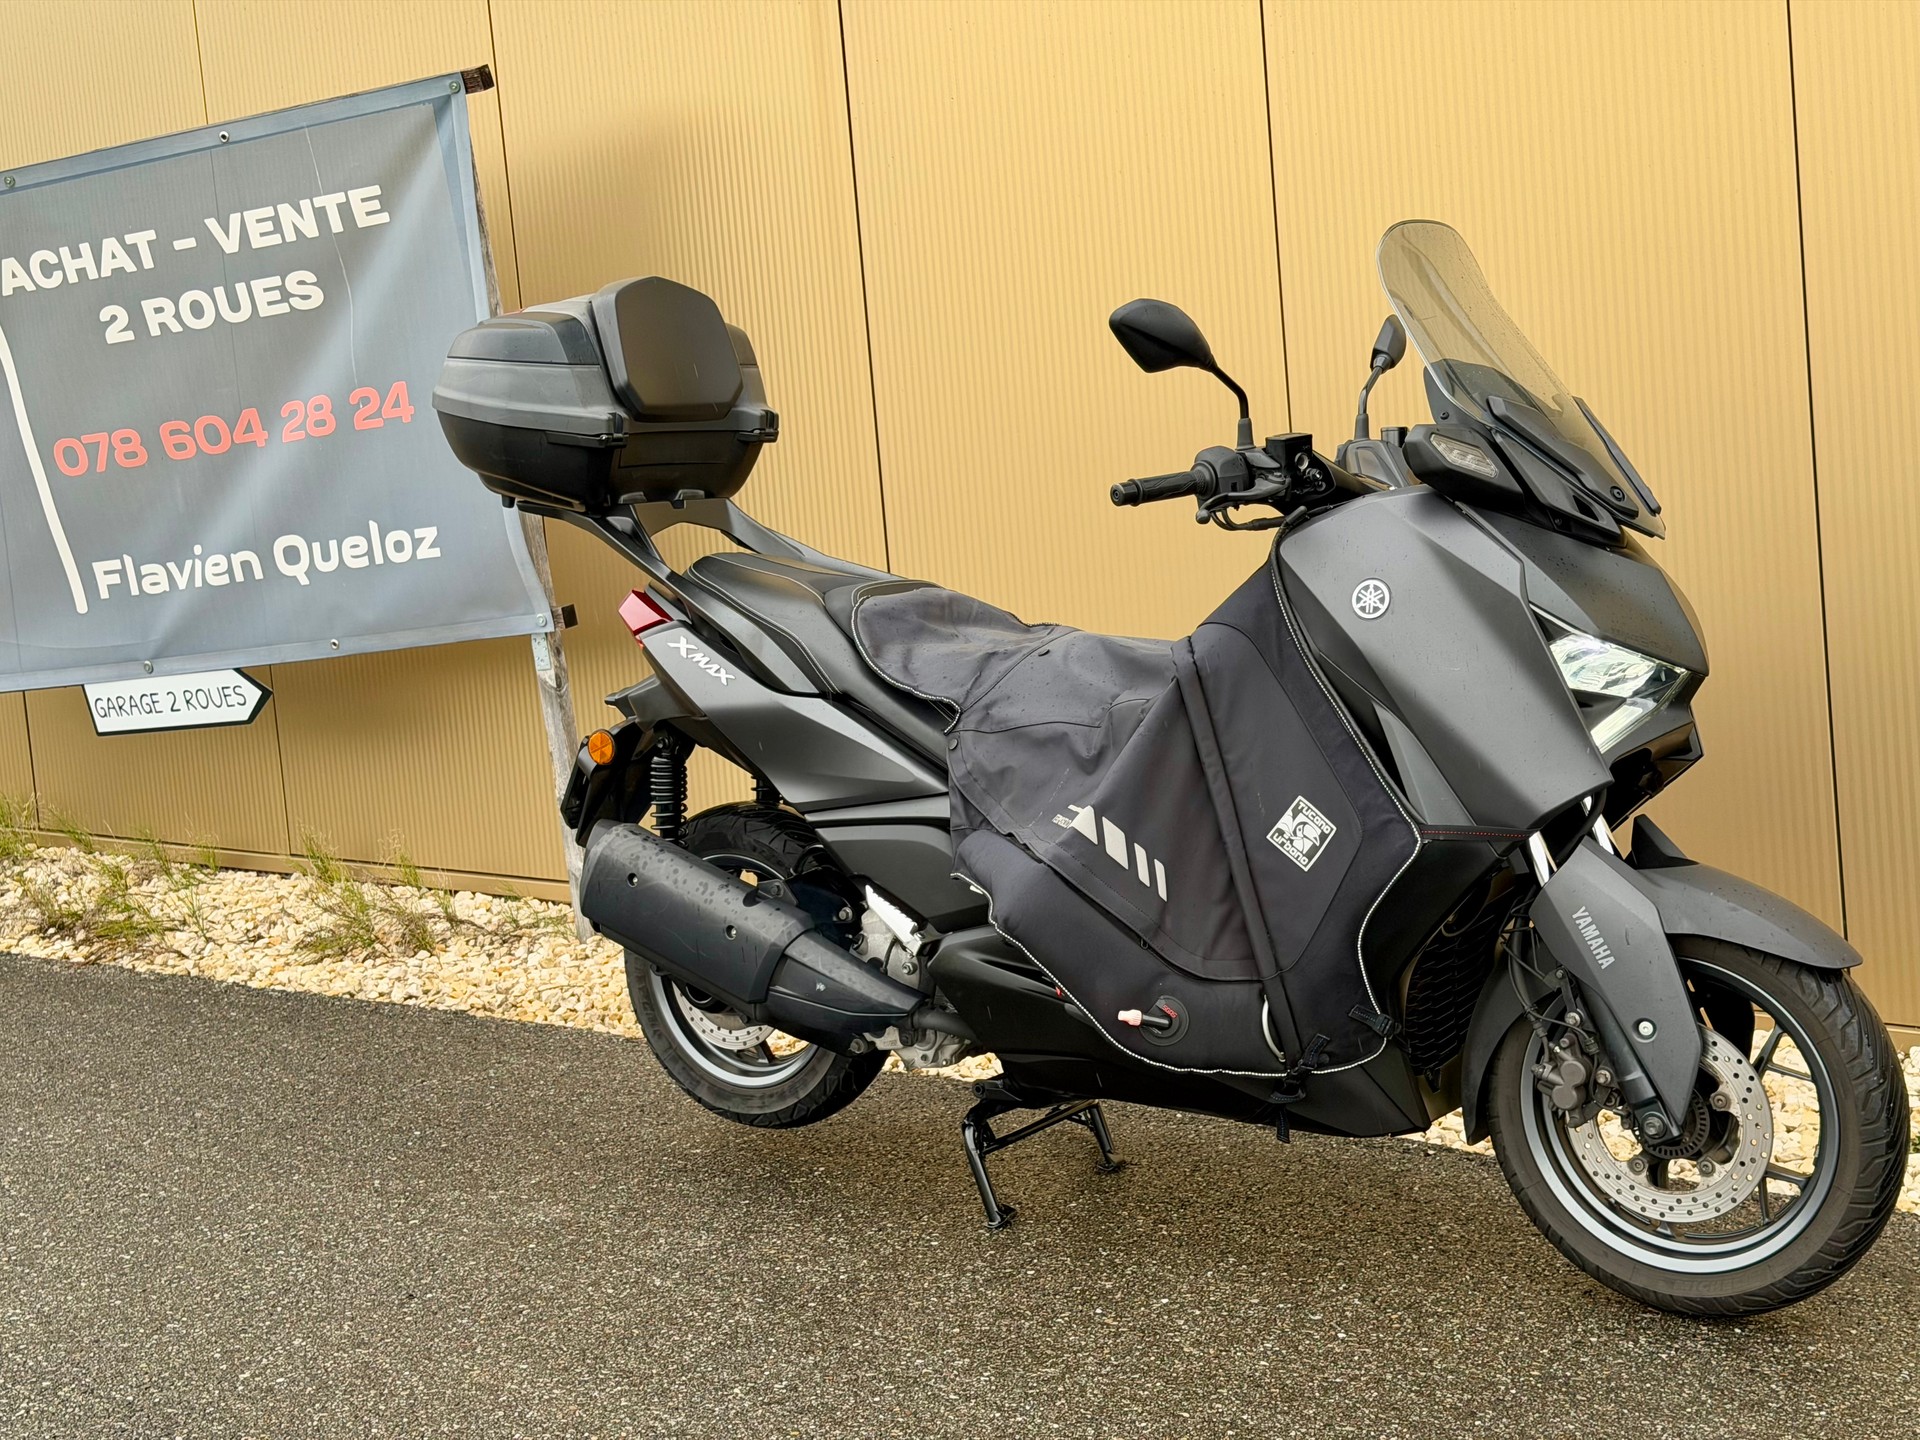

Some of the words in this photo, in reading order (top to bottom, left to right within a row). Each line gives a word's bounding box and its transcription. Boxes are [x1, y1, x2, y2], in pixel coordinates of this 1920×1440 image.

[1, 229, 157, 297] ACHAT
[172, 236, 198, 252] -
[204, 184, 391, 255] VENTE
[99, 304, 136, 345] 2
[140, 269, 325, 337] ROUES
[53, 428, 148, 477] 078
[159, 407, 269, 461] 604
[280, 394, 337, 444] 28
[349, 380, 415, 431] 24
[92, 544, 264, 600] Flavien
[273, 519, 441, 586] Queloz
[94, 692, 163, 719] GARAGE
[166, 691, 181, 713] 2
[182, 685, 247, 712] ROUES
[1572, 905, 1616, 970] YAMAHA
